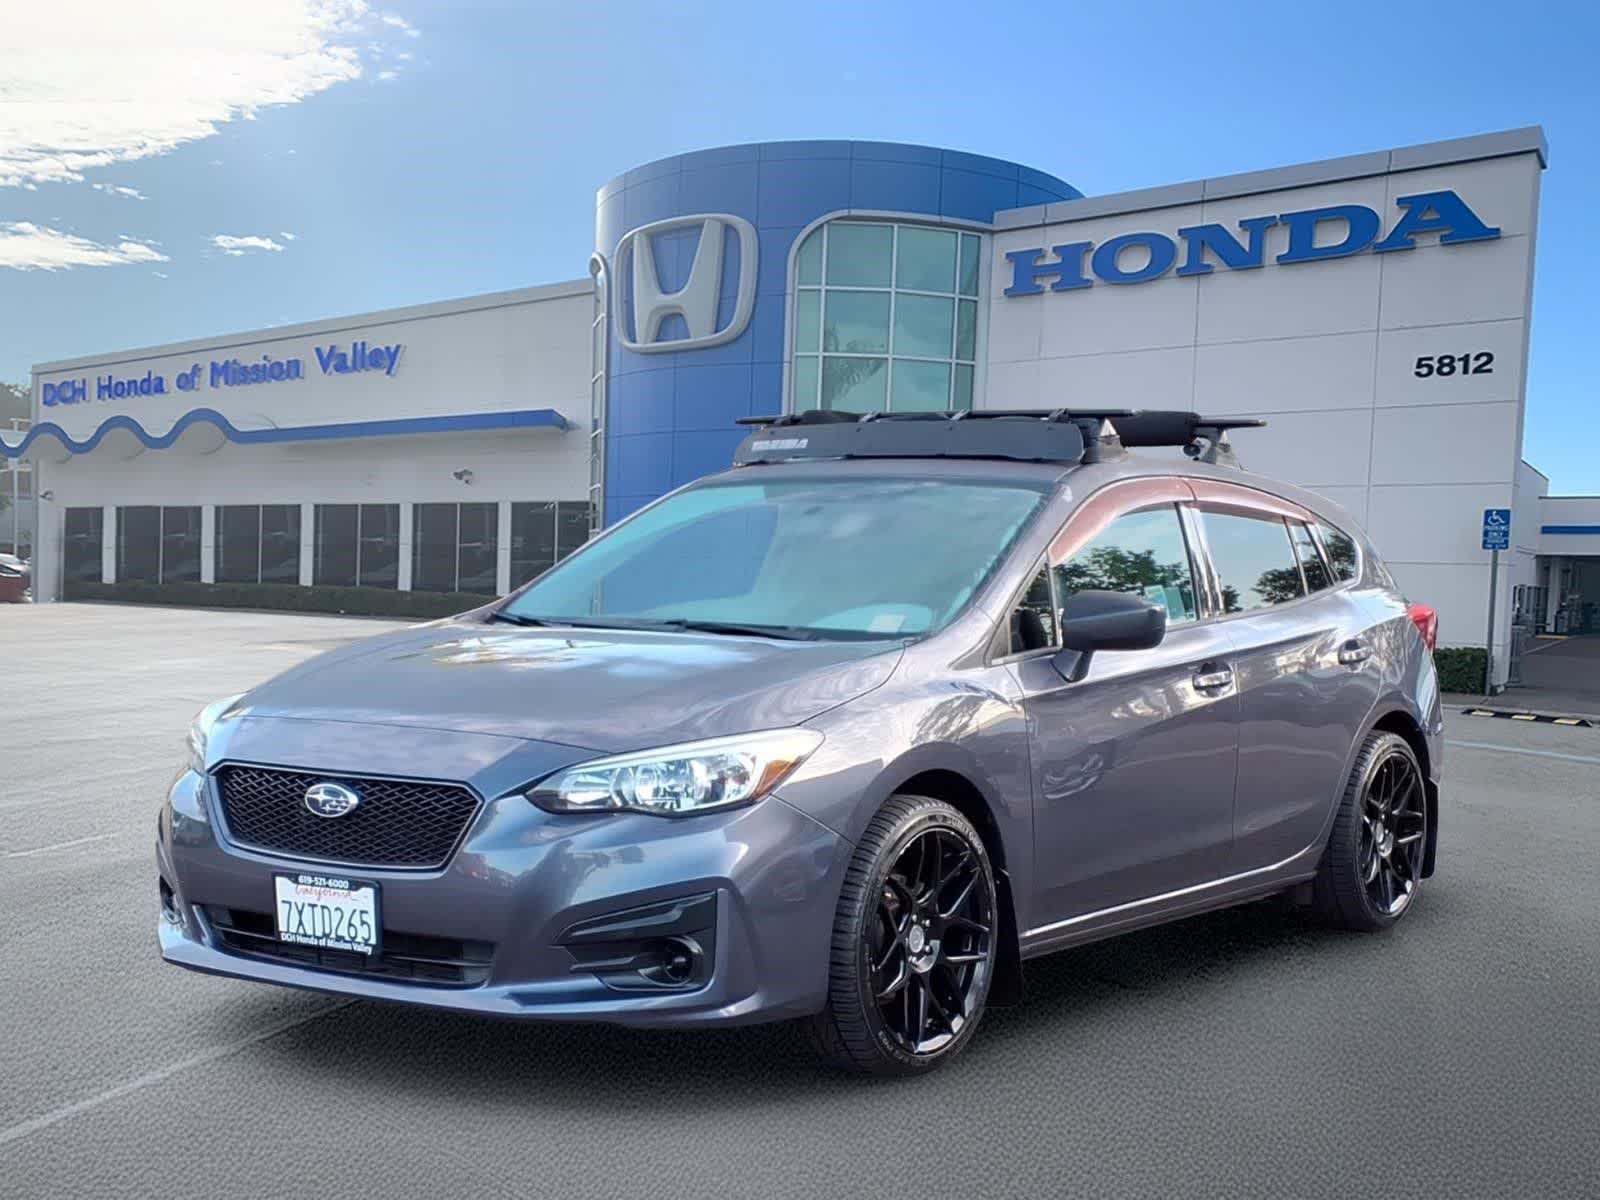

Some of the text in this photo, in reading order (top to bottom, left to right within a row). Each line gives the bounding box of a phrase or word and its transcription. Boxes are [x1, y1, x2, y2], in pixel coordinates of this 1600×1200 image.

[1003, 189, 1501, 297] HONDA
[42, 341, 402, 407] DCH Honda of Mission Valley
[1413, 350, 1495, 379] 5812
[281, 899, 372, 943] 7XTD265
[281, 932, 295, 942] DCH
[296, 934, 318, 945] Honda
